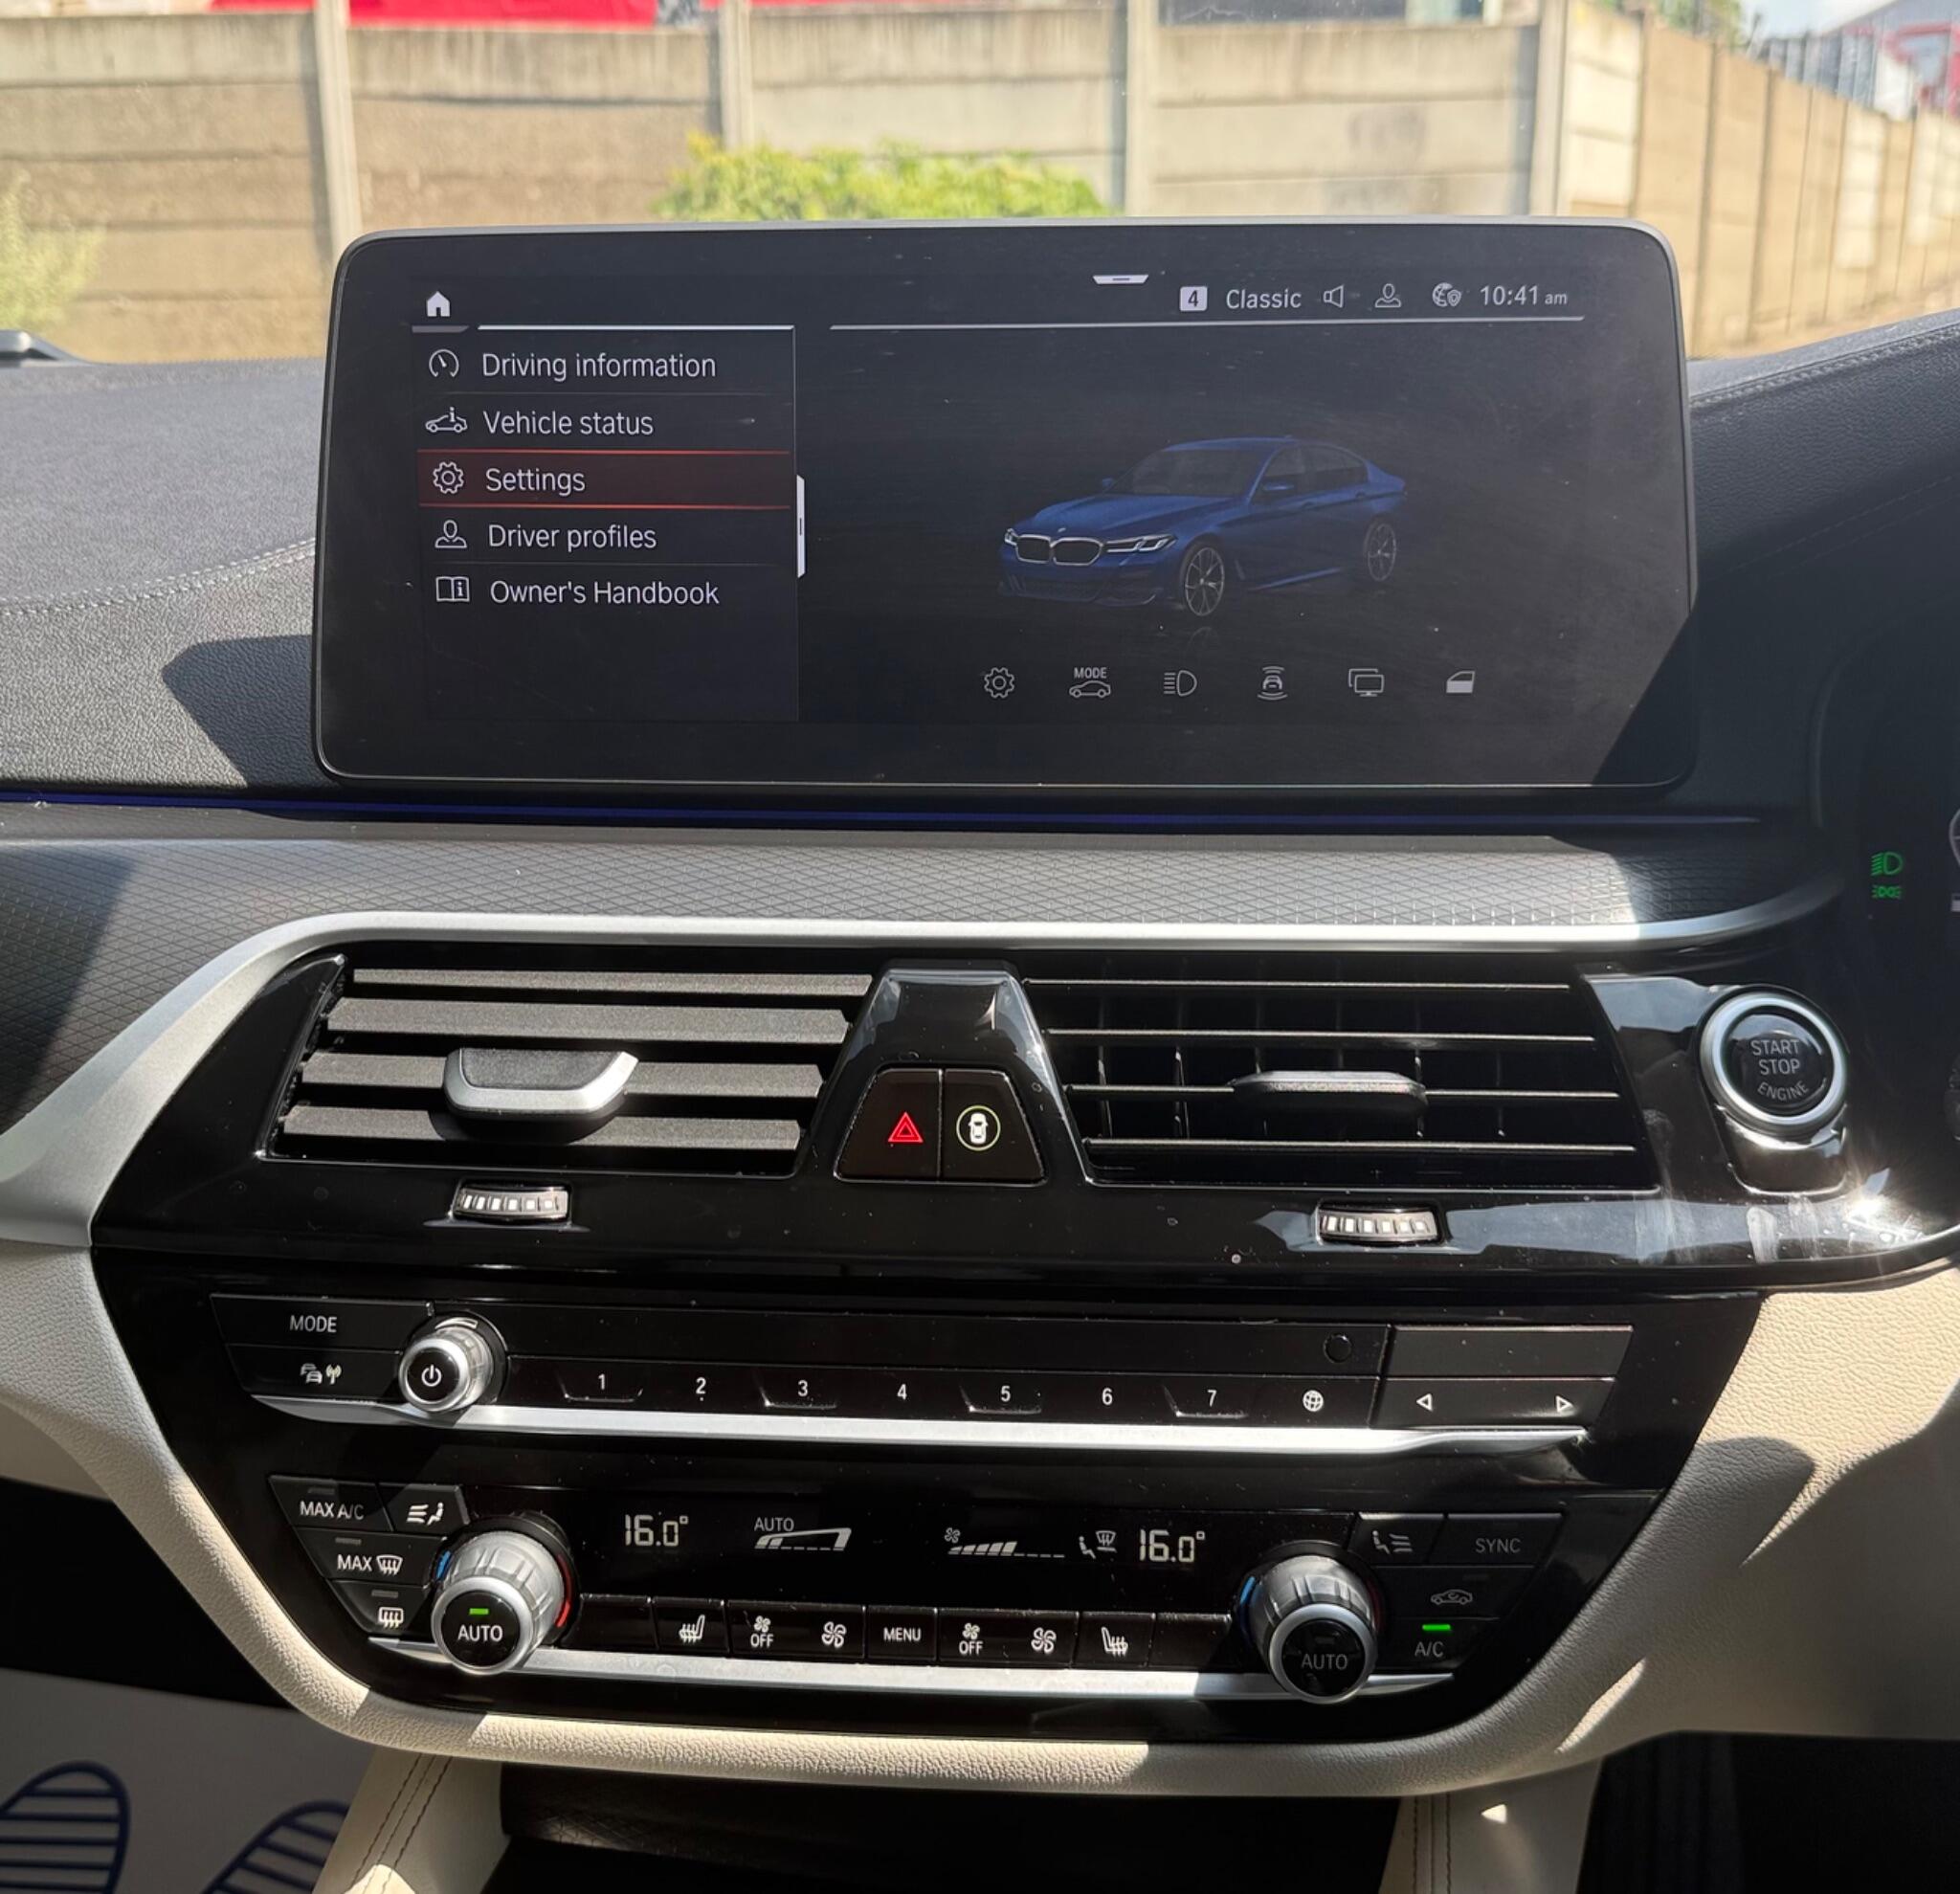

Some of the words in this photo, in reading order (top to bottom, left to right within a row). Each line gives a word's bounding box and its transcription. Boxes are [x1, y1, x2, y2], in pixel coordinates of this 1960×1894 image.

[1225, 288, 1302, 310] Classic
[1480, 284, 1540, 306] 10:41
[1544, 290, 1569, 306] am
[481, 351, 568, 382] Driving
[575, 351, 718, 378] information
[482, 410, 573, 435] Vehicle
[579, 411, 655, 436] status
[485, 467, 587, 497] Settings
[487, 524, 560, 548] Driver
[567, 524, 658, 553] profiles
[489, 579, 587, 605] Owner's
[592, 580, 721, 606] Handbook
[1075, 667, 1106, 680] MODE
[1750, 1039, 1799, 1056] START
[1758, 1059, 1800, 1075] STOP
[1757, 1081, 1809, 1100] ENGINE
[289, 1314, 338, 1334] MODE
[597, 1372, 607, 1391] 1
[695, 1376, 707, 1395] 2
[797, 1379, 810, 1398] 3
[896, 1382, 908, 1401] 4
[999, 1384, 1013, 1403] 5
[1102, 1387, 1114, 1406] 6
[1206, 1389, 1218, 1407] 7
[299, 1500, 335, 1518] MAX
[336, 1503, 365, 1521] A/C
[753, 1516, 795, 1532] AUTO
[1475, 1537, 1523, 1554] SYNC
[337, 1553, 373, 1571] MAX
[457, 1624, 503, 1643] AUTO
[750, 1633, 775, 1649] OFF
[882, 1626, 922, 1642] MENU
[958, 1640, 983, 1656] OFF
[1414, 1640, 1444, 1658] A/C
[1300, 1653, 1349, 1671] AUTO
